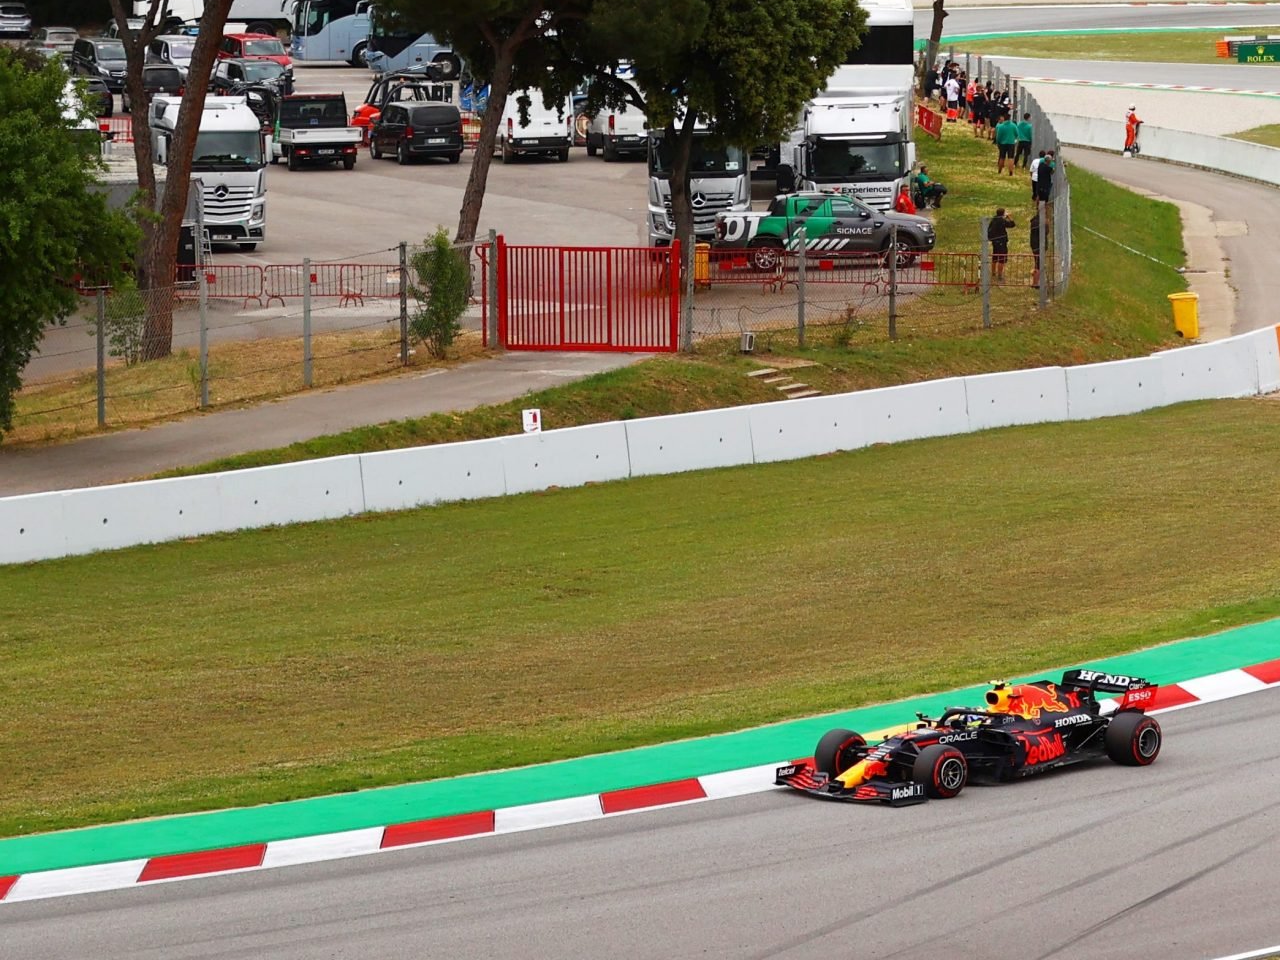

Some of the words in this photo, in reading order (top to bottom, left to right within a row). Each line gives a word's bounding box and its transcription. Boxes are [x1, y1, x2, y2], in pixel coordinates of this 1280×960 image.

[841, 186, 892, 195] Experiences
[1054, 714, 1092, 728] HONDA
[938, 731, 978, 744] ORACLE
[778, 766, 796, 777] telcel
[892, 785, 914, 801] Mobil
